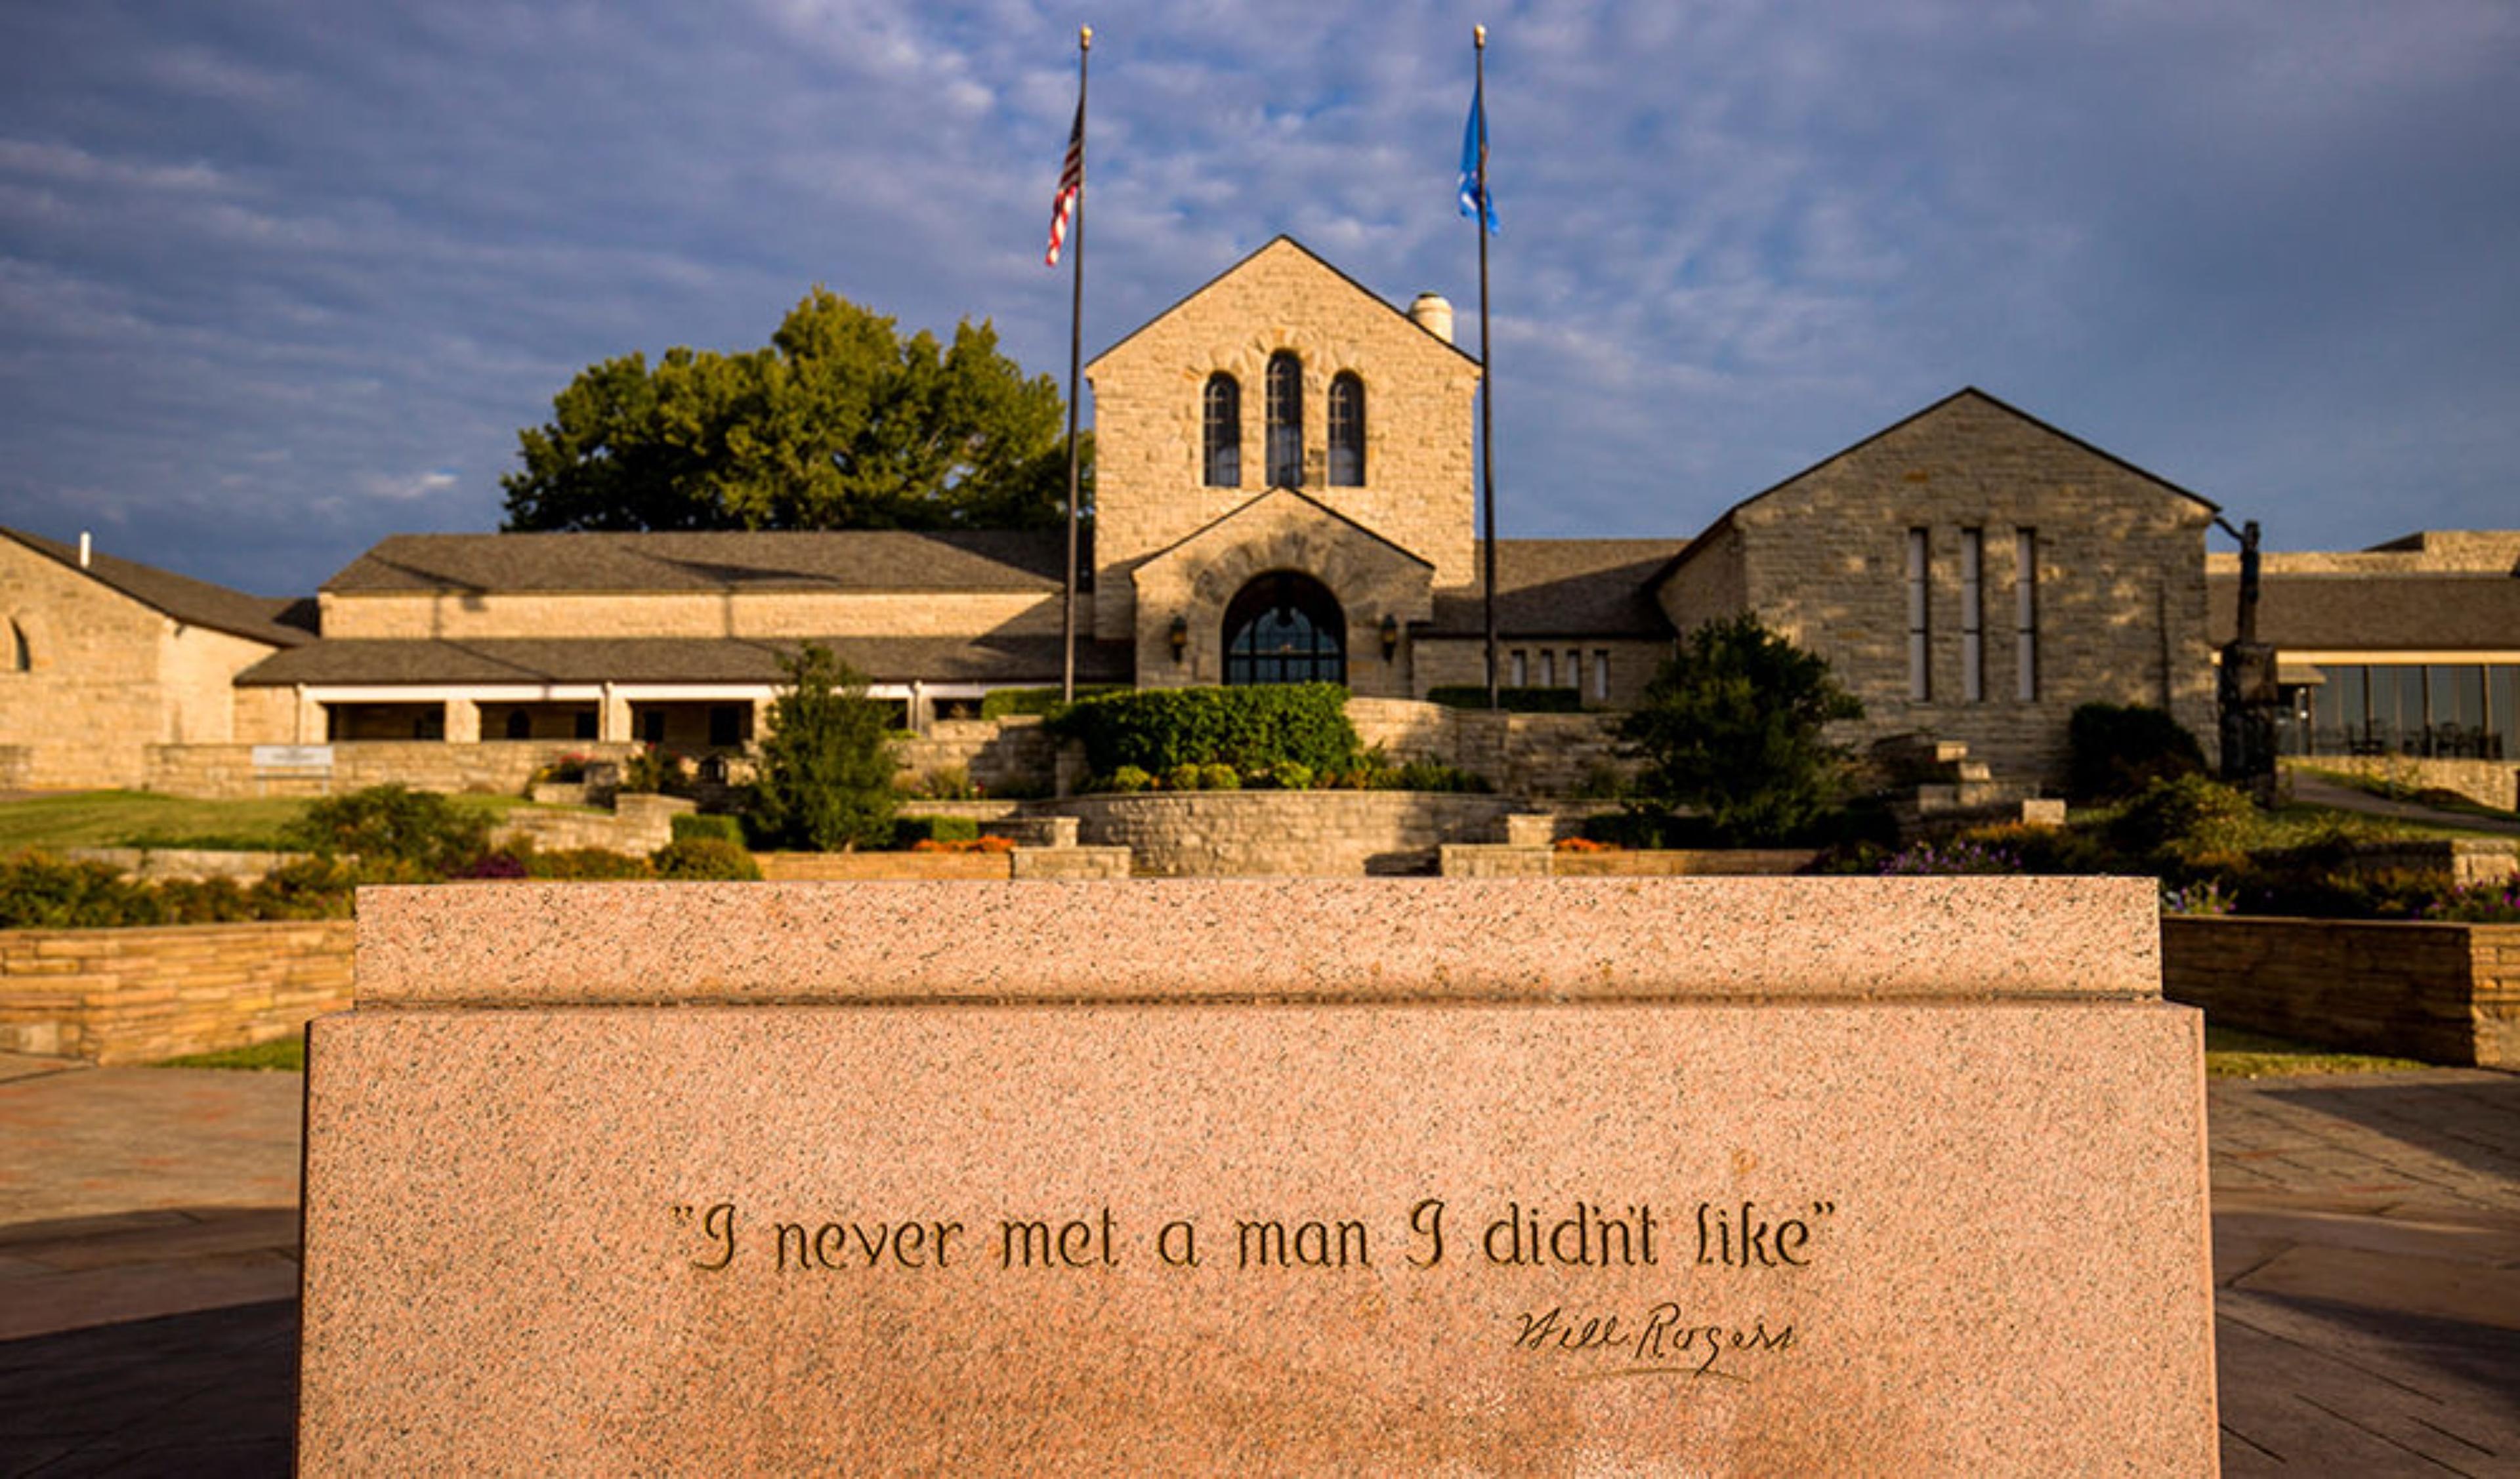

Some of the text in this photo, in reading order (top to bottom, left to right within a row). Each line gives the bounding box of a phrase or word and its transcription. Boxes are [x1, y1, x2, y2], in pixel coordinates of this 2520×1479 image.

[776, 1219, 965, 1271] never
[1001, 1206, 1120, 1269] met
[1158, 1219, 1200, 1269] a
[1237, 1218, 1370, 1270] man
[1407, 1199, 1446, 1270] I
[1635, 1302, 1796, 1377] Rogers
